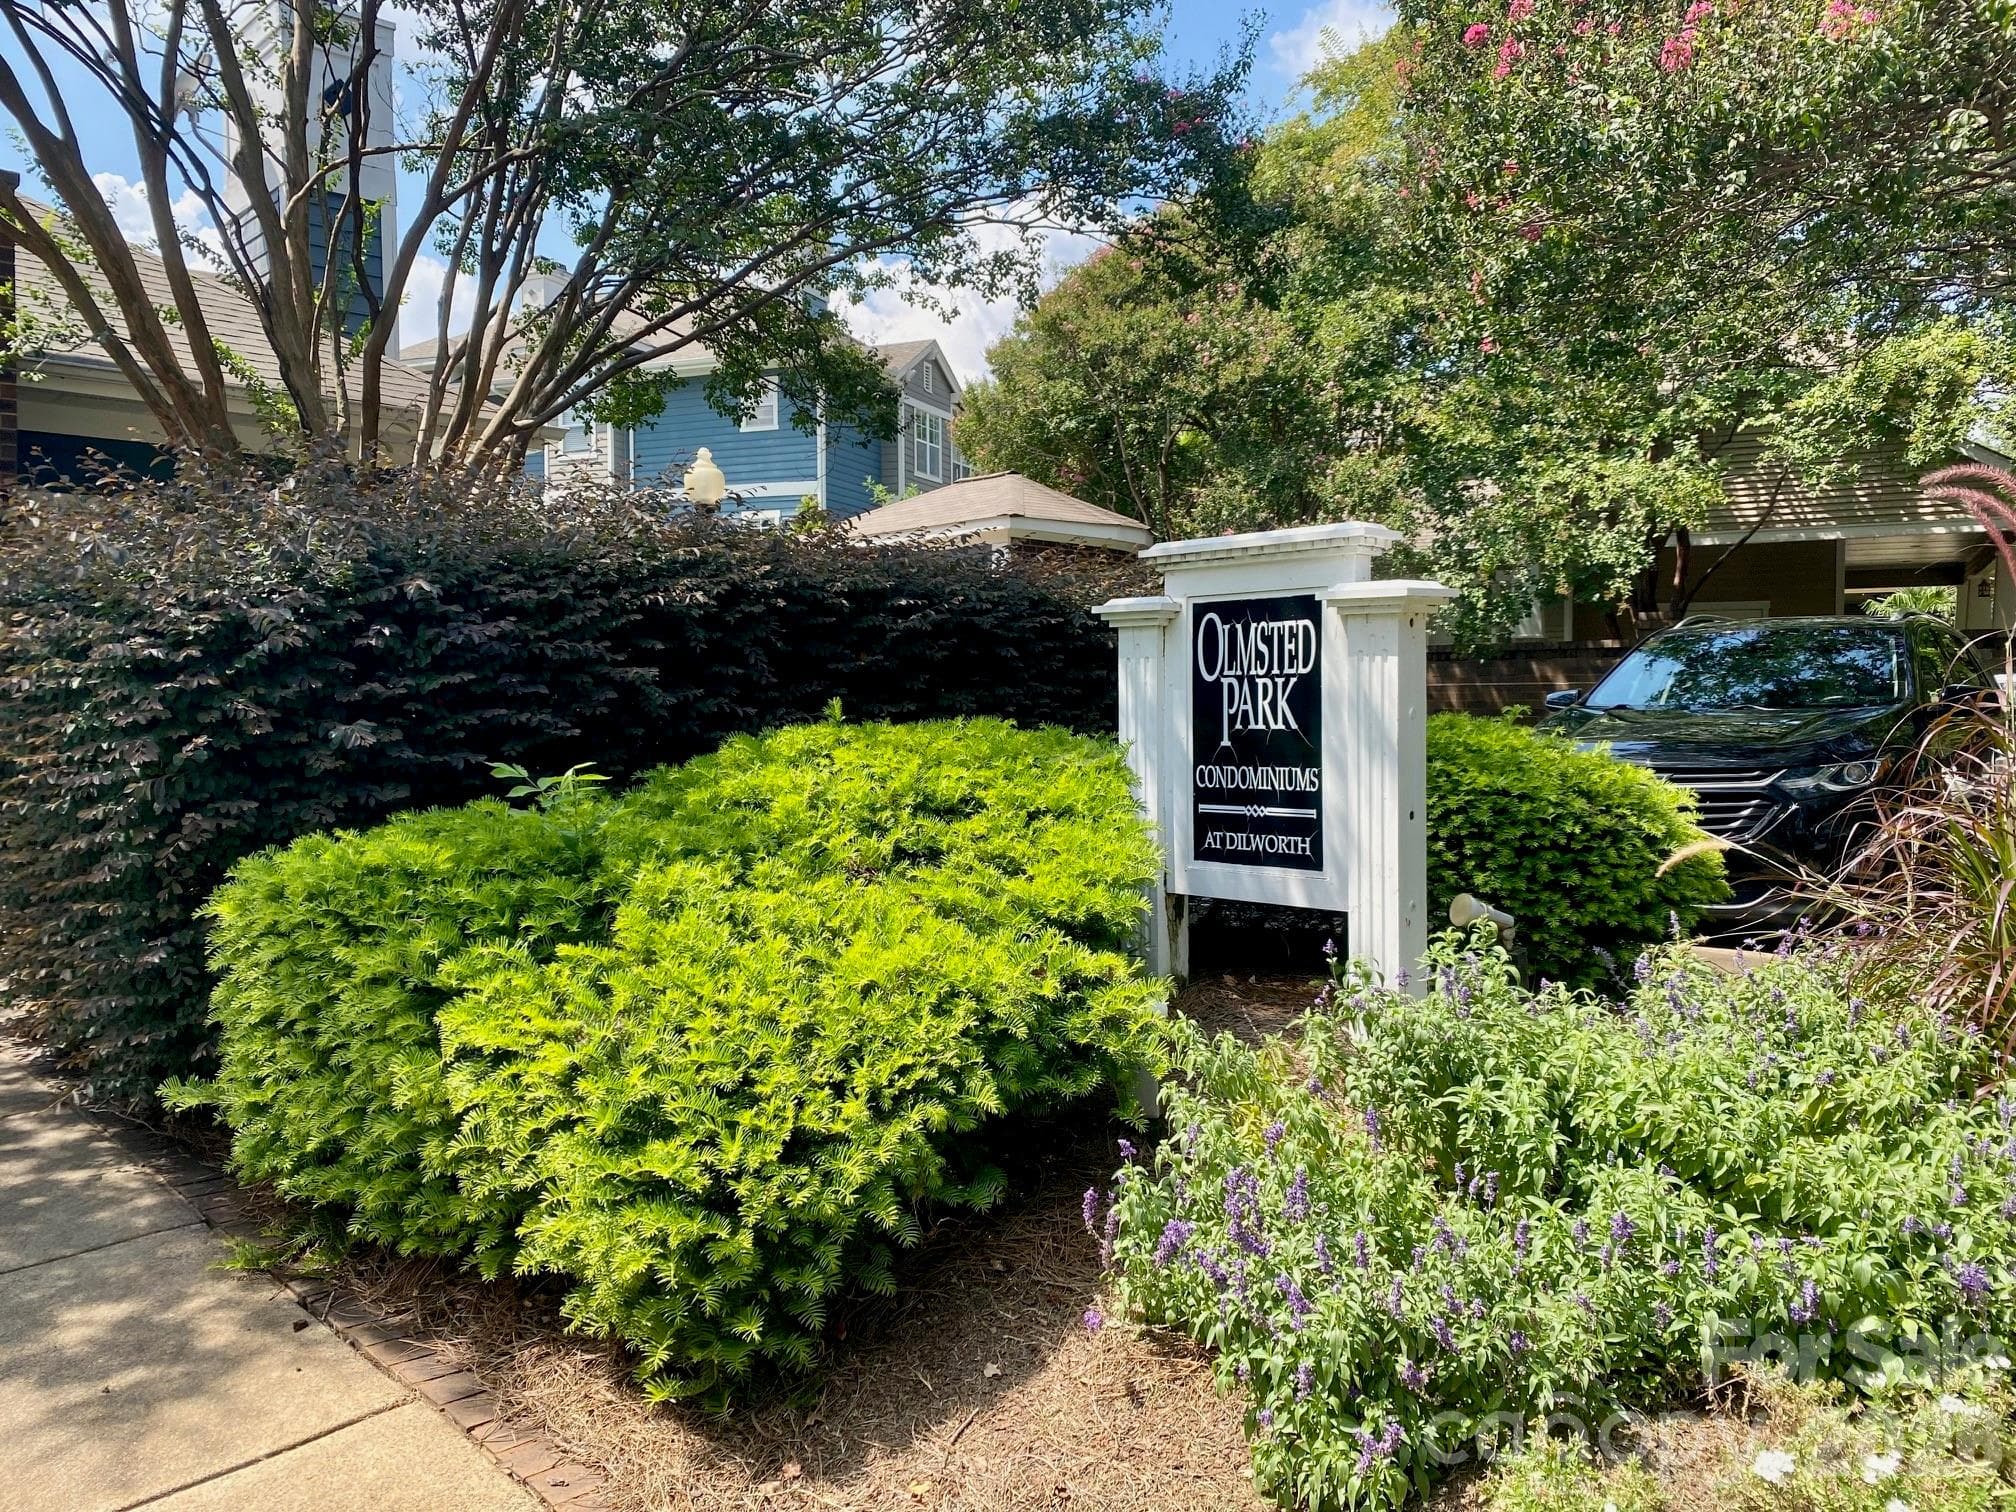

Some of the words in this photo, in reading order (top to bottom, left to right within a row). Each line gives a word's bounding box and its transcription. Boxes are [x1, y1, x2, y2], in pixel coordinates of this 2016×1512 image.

[1197, 612, 1317, 682] OLMSTED
[1220, 677, 1299, 746] PARK
[1196, 765, 1319, 792] CONDOMINIUMS
[1204, 831, 1224, 850] AT
[1226, 832, 1312, 855] DILWORTH
